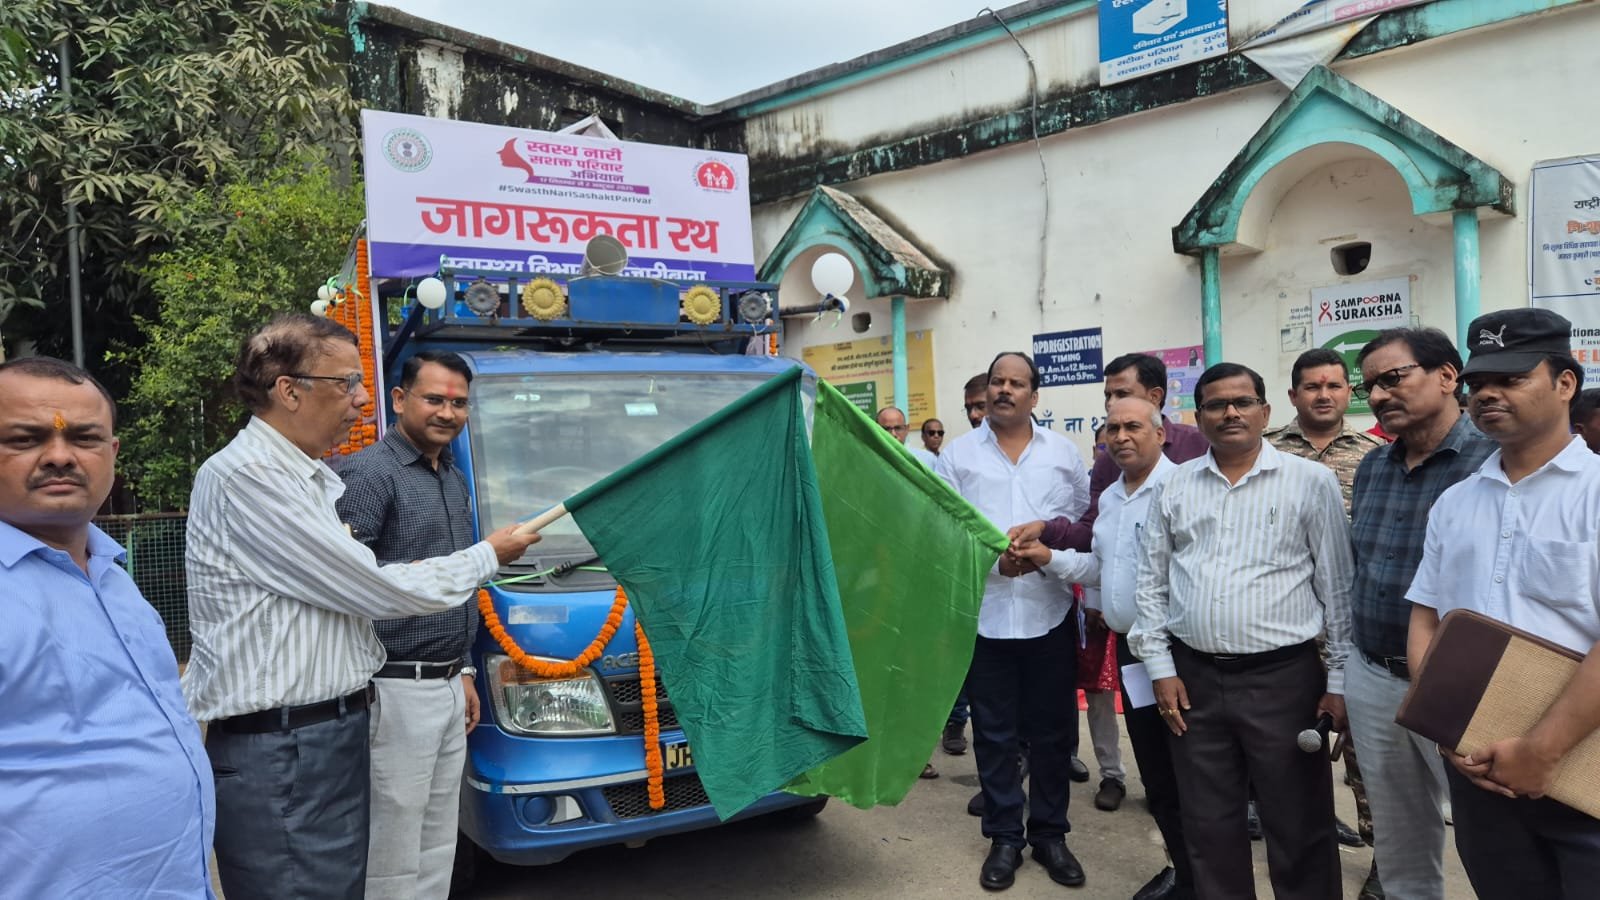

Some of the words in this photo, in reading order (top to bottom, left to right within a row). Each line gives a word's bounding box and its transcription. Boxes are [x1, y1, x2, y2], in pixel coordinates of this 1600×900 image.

[525, 140, 578, 157] स्वस्थ
[582, 147, 623, 162] नारी
[528, 154, 572, 167] सशक्त
[575, 158, 624, 173] परिवार
[570, 169, 624, 183] अभियान
[498, 184, 653, 205] #SwasthNariSashaktParivar
[416, 196, 660, 249] जागरूकता
[666, 216, 719, 254] रथ
[1335, 303, 1403, 321] SURAKSHA
[1049, 334, 1102, 353] REGISTRATION
[1051, 353, 1081, 364] TIMING
[670, 748, 694, 769] JH
